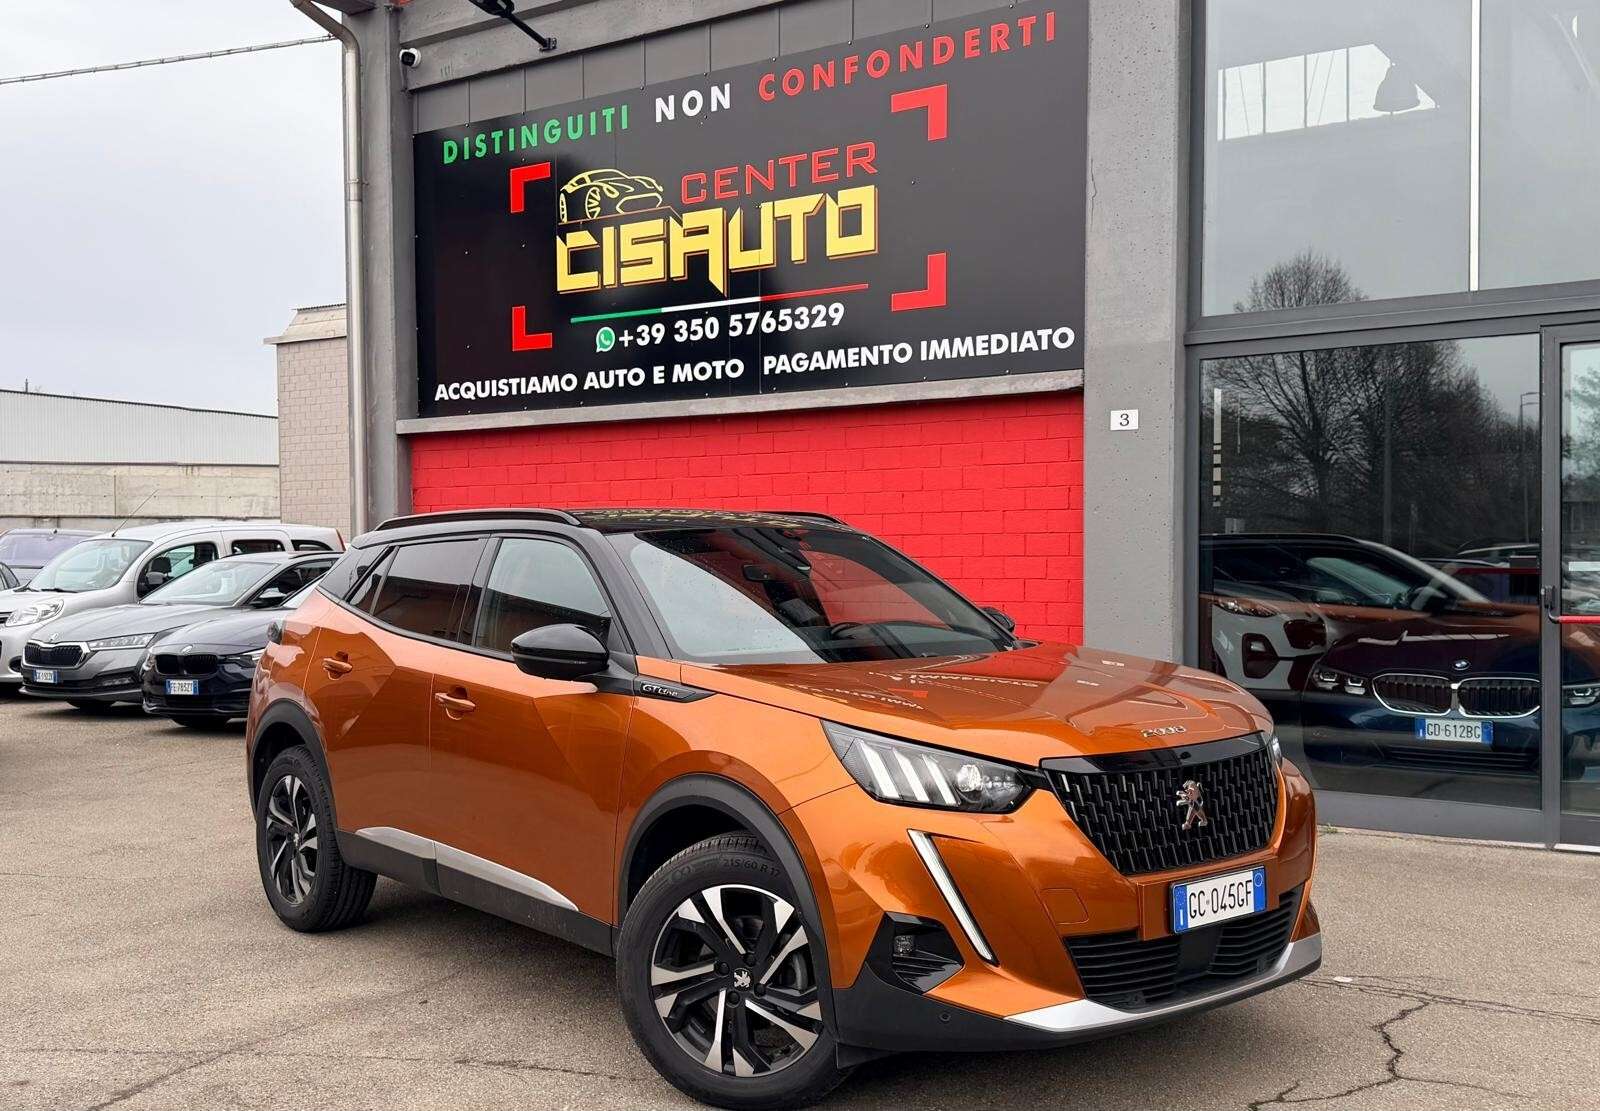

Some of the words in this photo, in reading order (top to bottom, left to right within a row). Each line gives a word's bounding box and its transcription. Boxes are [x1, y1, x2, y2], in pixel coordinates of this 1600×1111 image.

[443, 104, 629, 165] DISTINGUITI
[655, 82, 731, 123] NON
[758, 11, 1055, 101] CONFONDERTI
[681, 141, 878, 205] CENTER
[556, 184, 879, 297] CISAUTO
[618, 322, 665, 348] +39
[674, 316, 719, 342] 350
[729, 302, 845, 337] 5765329
[434, 374, 577, 401] ACQUISTIAMO
[583, 367, 646, 391] AUTO
[653, 364, 665, 385] E
[672, 358, 745, 384] MOTO
[763, 342, 912, 375] PAGAMENTO
[920, 326, 1075, 361] IMMEDIATO
[1119, 413, 1130, 427] 3
